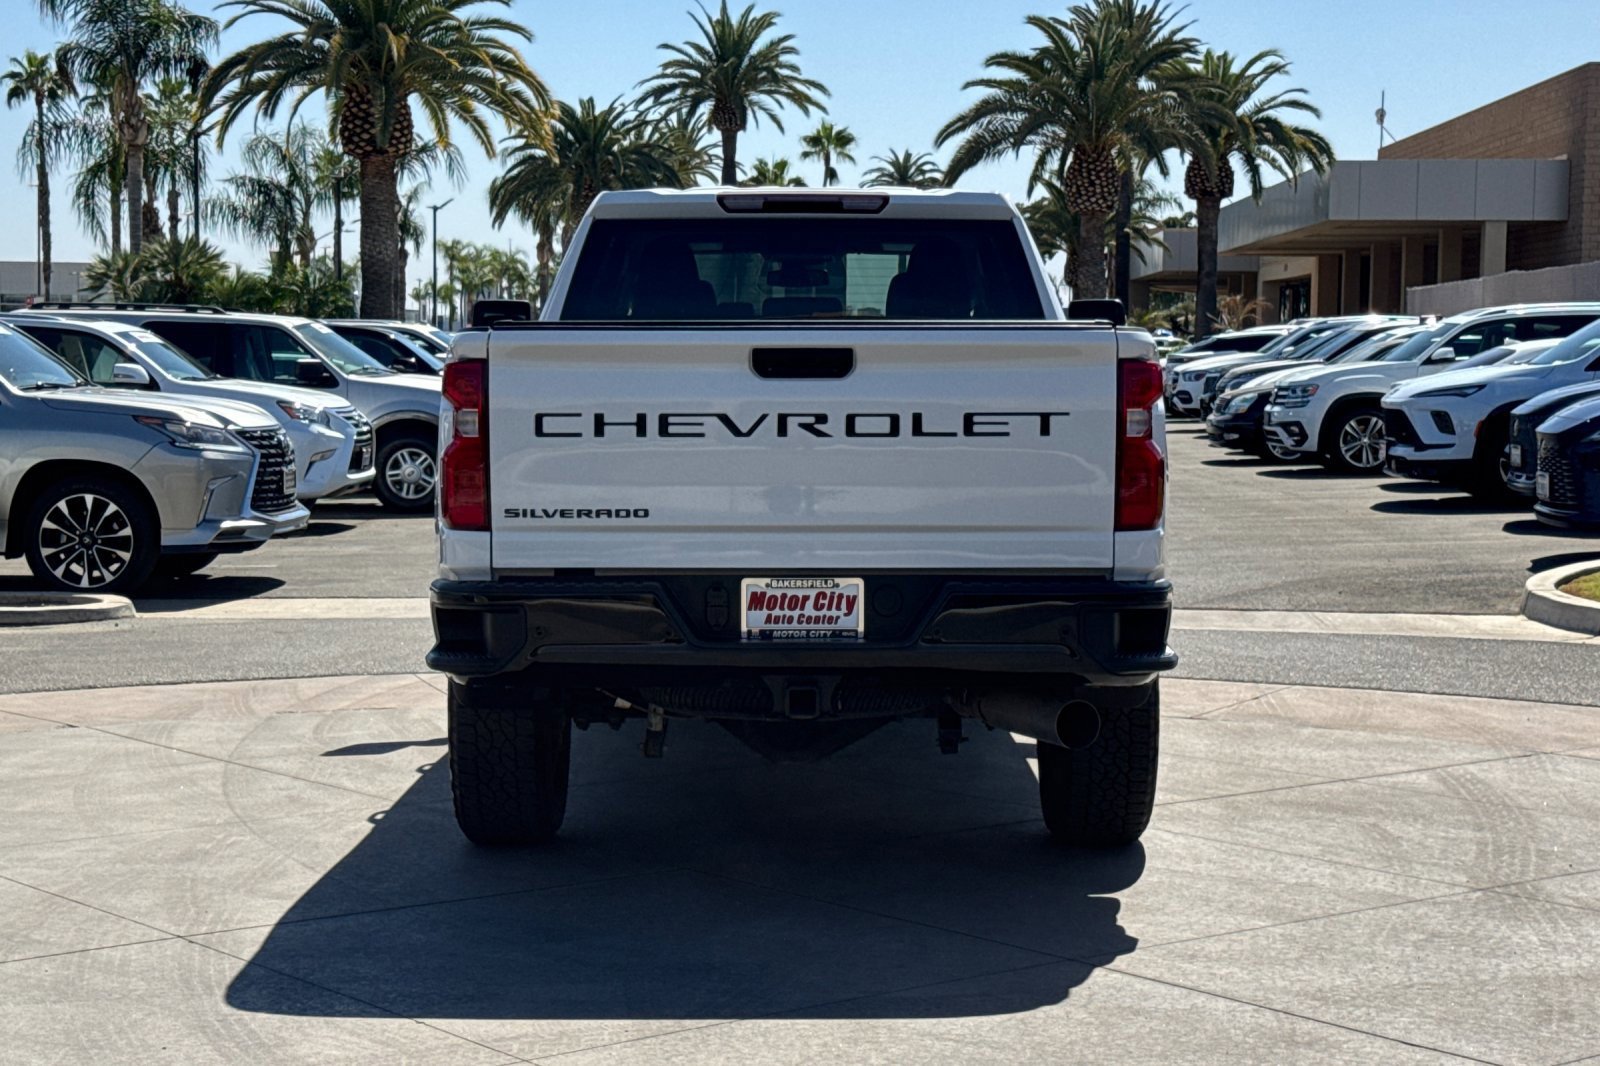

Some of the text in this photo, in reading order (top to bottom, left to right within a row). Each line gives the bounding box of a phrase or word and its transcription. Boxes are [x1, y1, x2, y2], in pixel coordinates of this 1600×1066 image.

[534, 412, 1070, 438] CHEVROLET
[504, 508, 650, 519] SILVERADO
[771, 580, 834, 588] BAKERSFIELD
[747, 591, 857, 617] Motor City
[764, 613, 841, 625] Auto Center
[772, 630, 833, 638] MOTOR CITY
